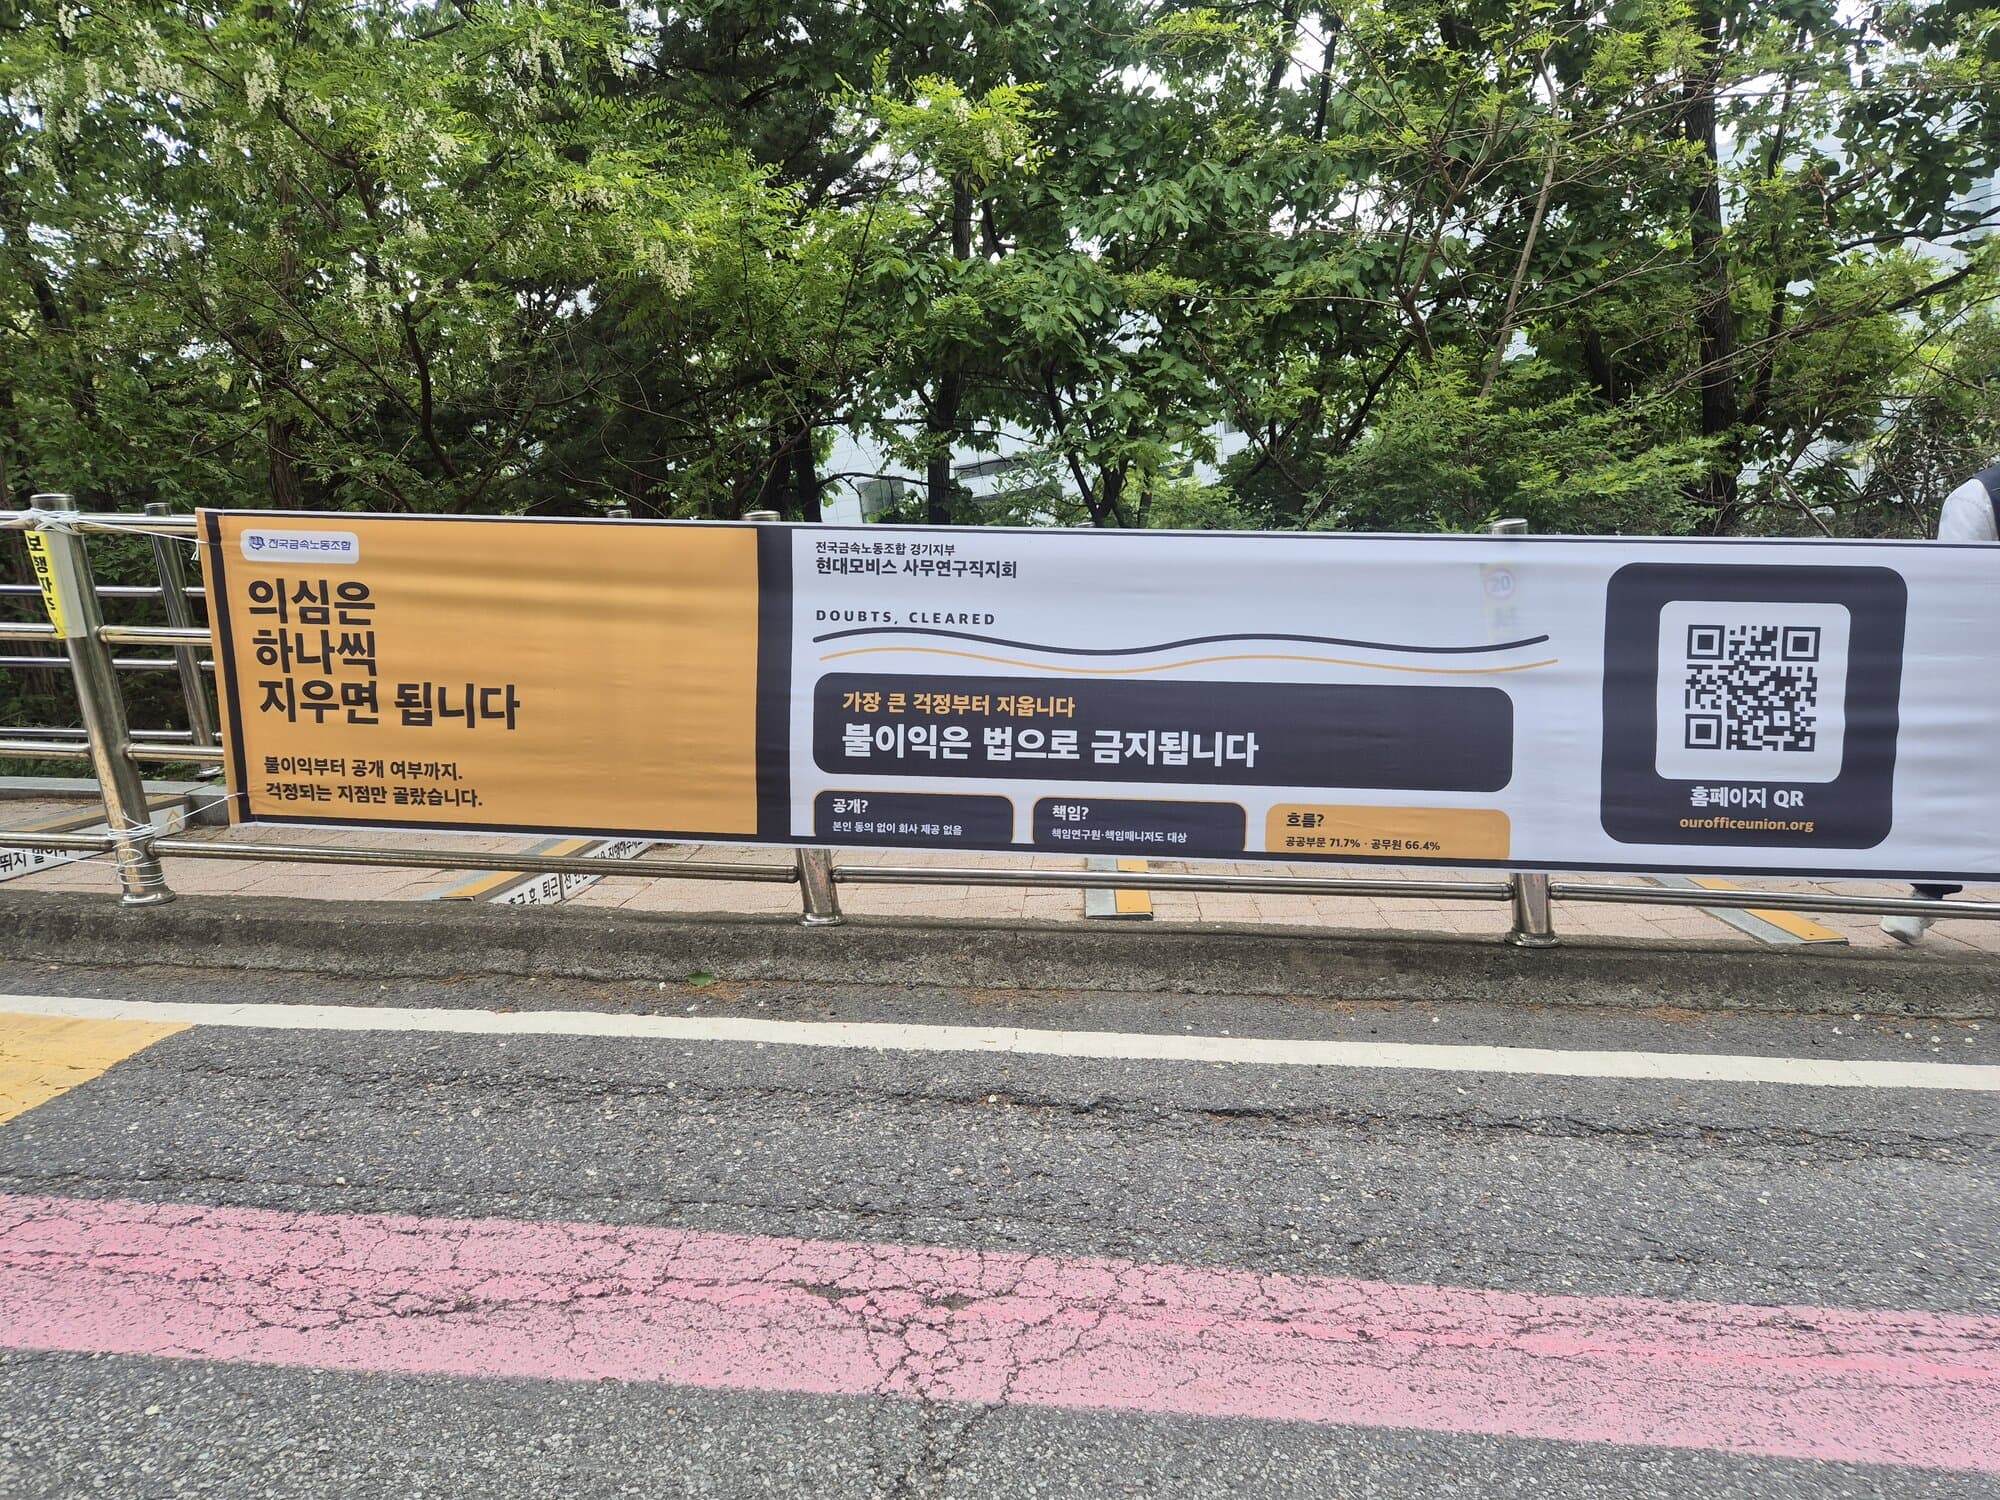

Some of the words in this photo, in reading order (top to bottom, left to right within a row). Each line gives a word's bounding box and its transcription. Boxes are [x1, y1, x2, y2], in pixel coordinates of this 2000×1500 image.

[268, 538, 351, 551] 전국금속노동조합
[816, 541, 906, 555] 전국금속노동조합
[910, 543, 956, 556] 경기지부
[816, 557, 897, 575] 현대모비스
[902, 558, 1017, 579] 사무연구직지회
[248, 578, 376, 625] 의심은
[816, 610, 898, 625] DOUBTS,
[909, 611, 996, 625] CLEARED
[252, 628, 377, 676] 하나씩
[258, 678, 379, 725] 지우면
[394, 682, 520, 729] 됩니다
[842, 691, 881, 713] 가장
[887, 693, 906, 714] 큰
[912, 693, 990, 716] 걱정부터
[996, 695, 1076, 718] 지웁니다
[842, 723, 972, 760] 불이익은
[983, 726, 1081, 761] 법으로
[1091, 730, 1260, 768] 금지됩니다
[264, 756, 346, 777] 불이익부터
[351, 759, 384, 779] 공개
[390, 760, 463, 781] 여부까지.
[266, 782, 332, 801] 걱정되는
[338, 785, 387, 803] 지점만
[393, 787, 483, 807] 골랐습니다.
[1690, 786, 1766, 808] 홈페이지
[1773, 789, 1804, 808] QR
[832, 798, 869, 815] 공개?
[1052, 805, 1089, 821] 책임?
[832, 821, 852, 832] 본인
[854, 822, 874, 833] 동의
[876, 822, 896, 834] 없이
[898, 823, 918, 834] 회사
[920, 824, 940, 835] 제공
[943, 825, 963, 836] 없음
[1286, 812, 1325, 828] 흐름?
[1679, 816, 1815, 833] ourofficeunion.org
[1167, 832, 1187, 844] 대상
[1285, 836, 1326, 848] 공공부문
[1329, 838, 1361, 848] 71.7%
[1371, 839, 1402, 850] 공무원
[1405, 840, 1441, 850] 66.4%
